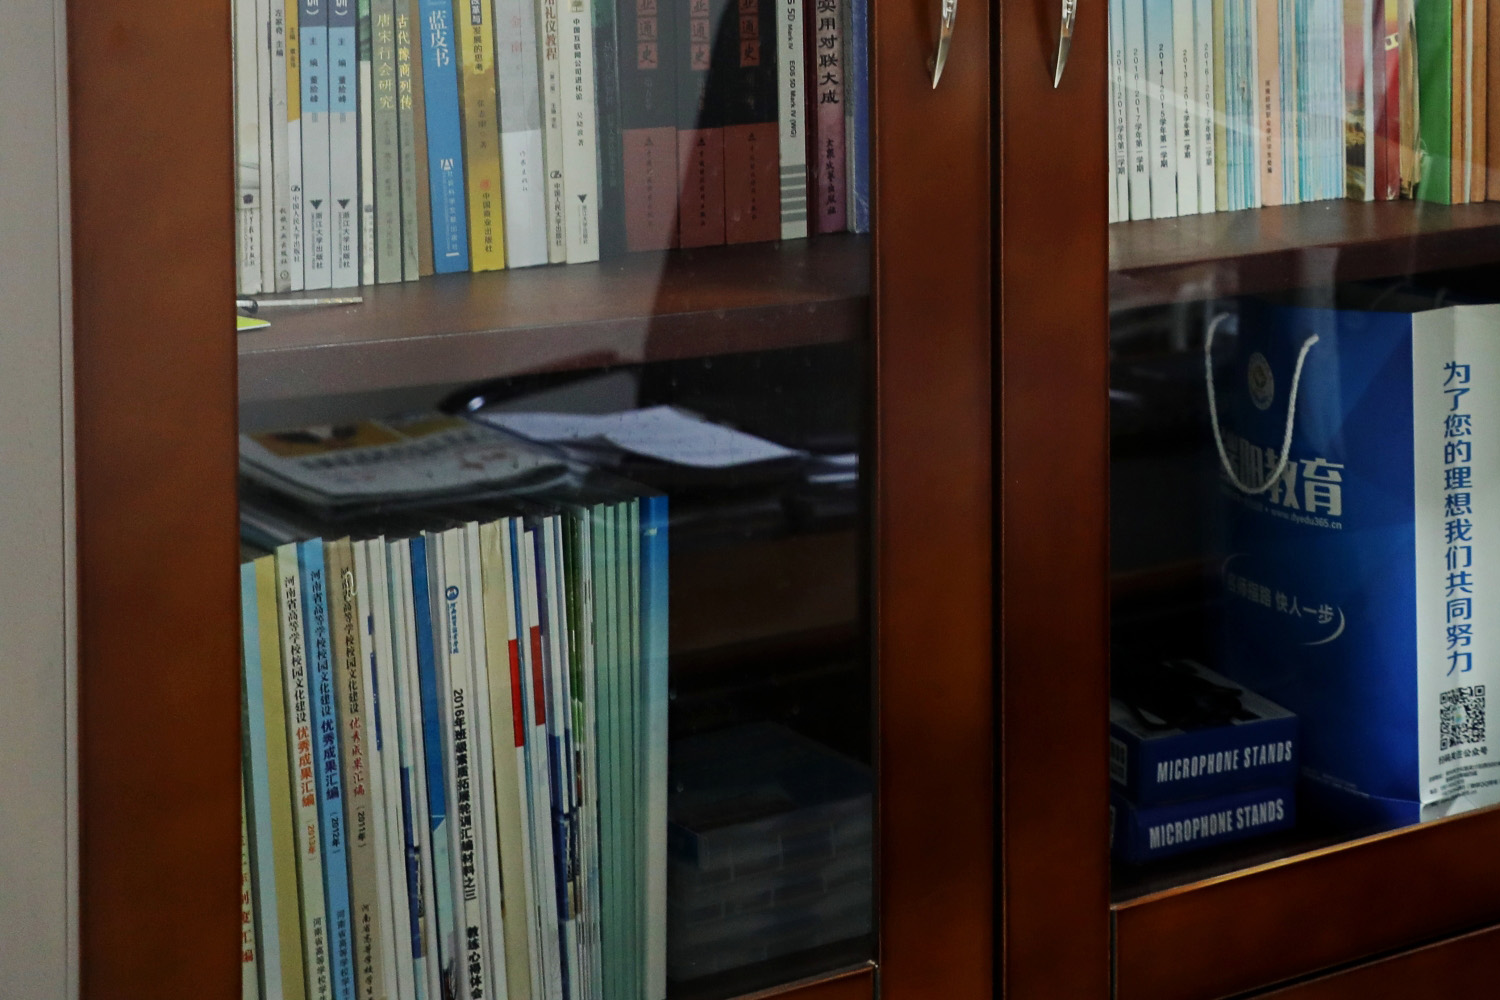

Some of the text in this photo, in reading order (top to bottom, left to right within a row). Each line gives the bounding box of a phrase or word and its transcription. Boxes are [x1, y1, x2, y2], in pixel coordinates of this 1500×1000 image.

[376, 13, 394, 110] 唐宋行会研究
[397, 15, 413, 110] 古代豫商列传
[429, 10, 450, 68] 蓝皮书
[315, 212, 324, 269] 浙江大学出版社
[343, 212, 351, 268] 浙江大学出版社
[483, 192, 494, 253] 中国商业出版社
[1443, 361, 1473, 677] 为了您的理想我们共同努力
[296, 727, 315, 808] 优秀成果汇编
[320, 720, 340, 801] 优秀成果汇编
[1157, 741, 1292, 783] MICROPHONE STANDS
[1150, 798, 1284, 849] MICROPHONE STANDS
